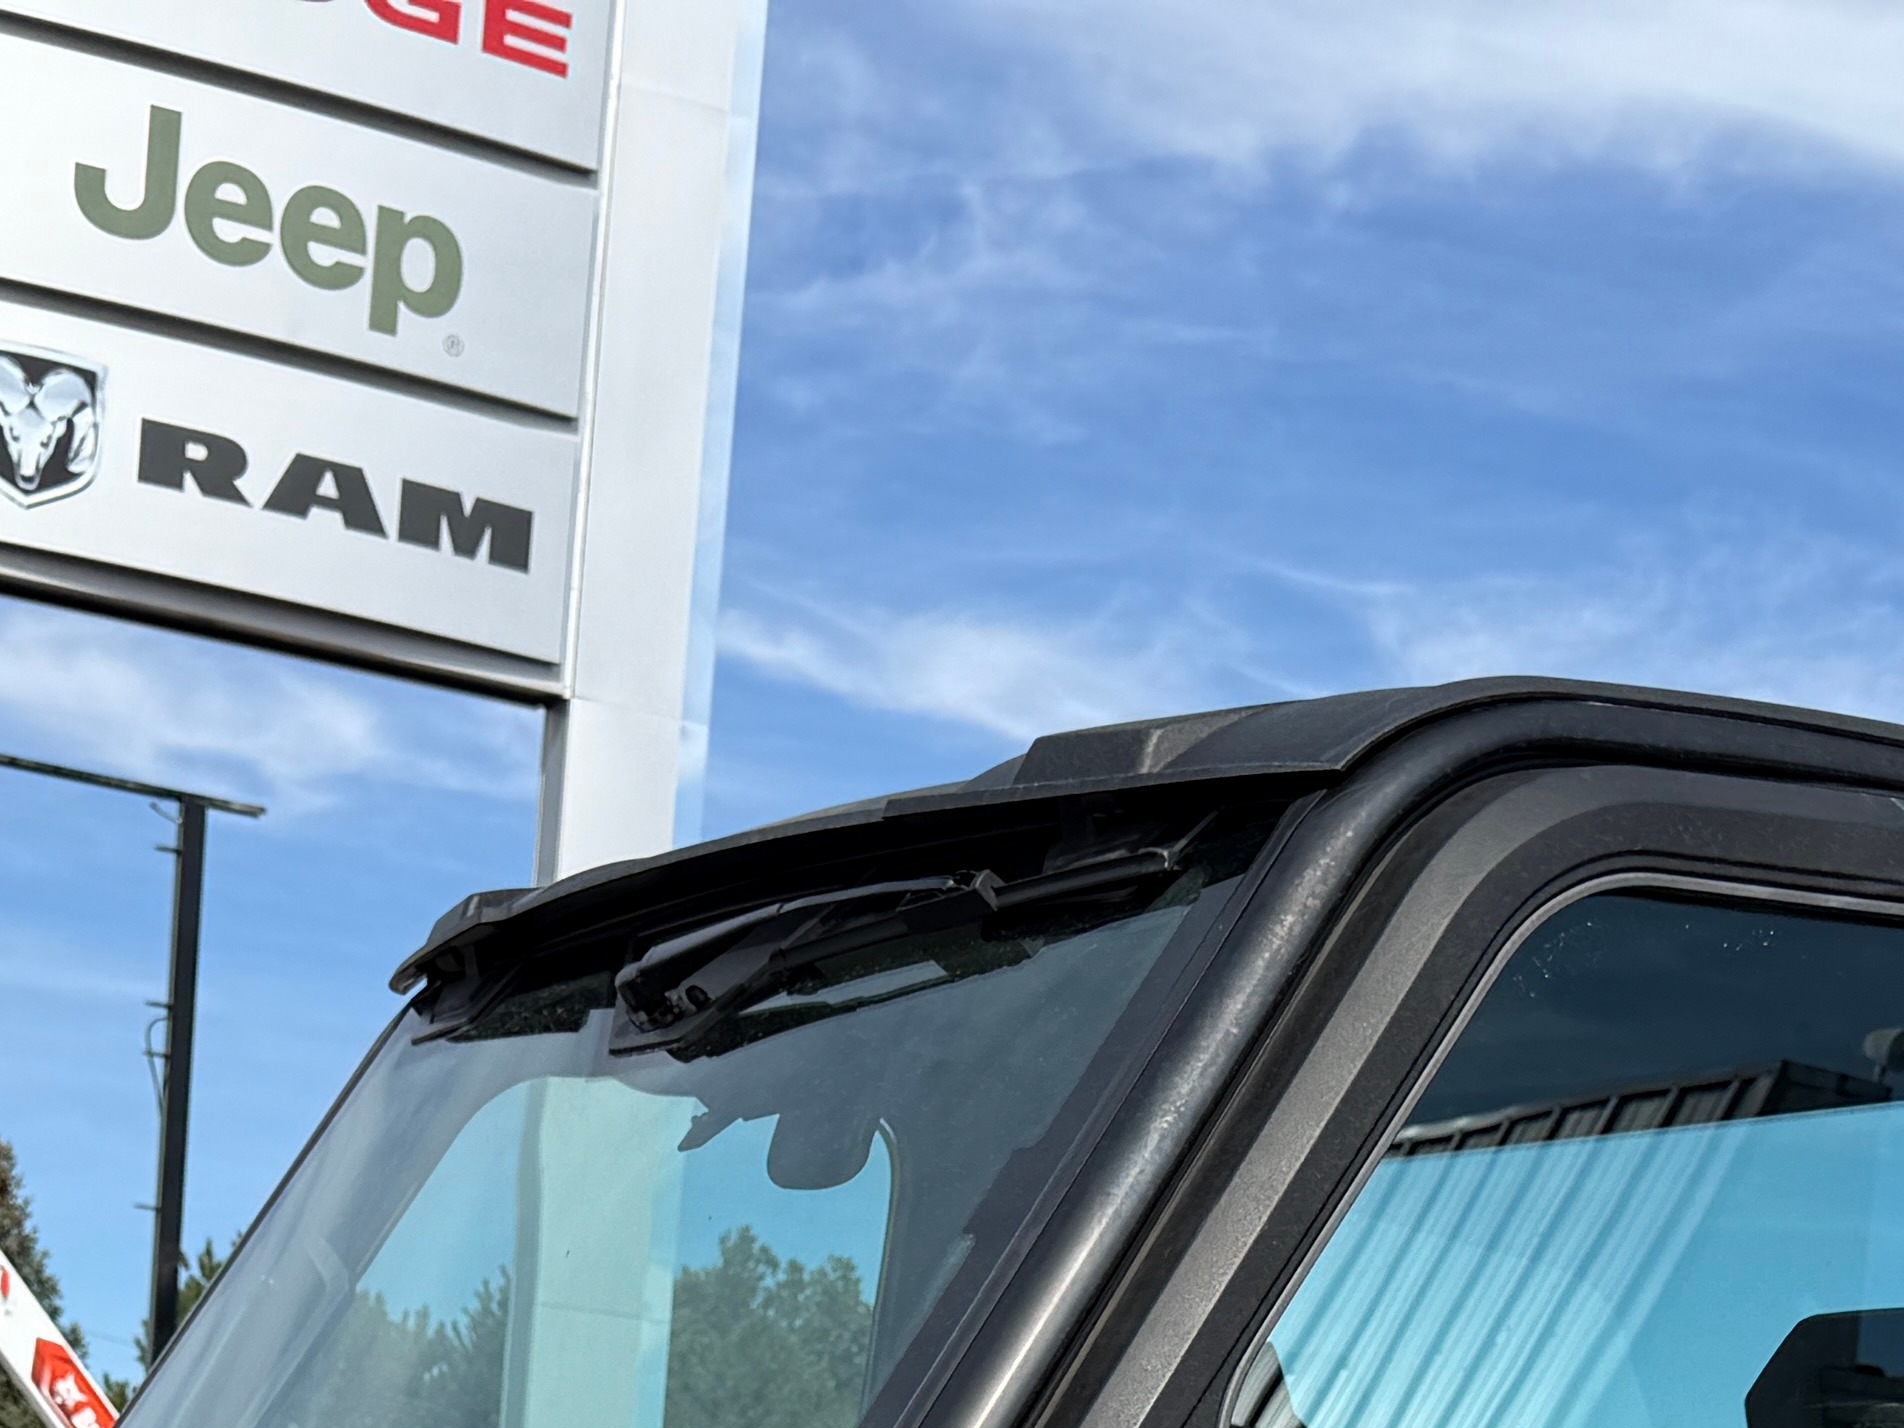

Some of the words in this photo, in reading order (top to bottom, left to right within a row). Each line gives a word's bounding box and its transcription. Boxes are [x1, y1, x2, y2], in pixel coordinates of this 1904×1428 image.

[296, 0, 572, 79] GE
[73, 105, 464, 337] Jeep
[137, 417, 534, 575] RAM
